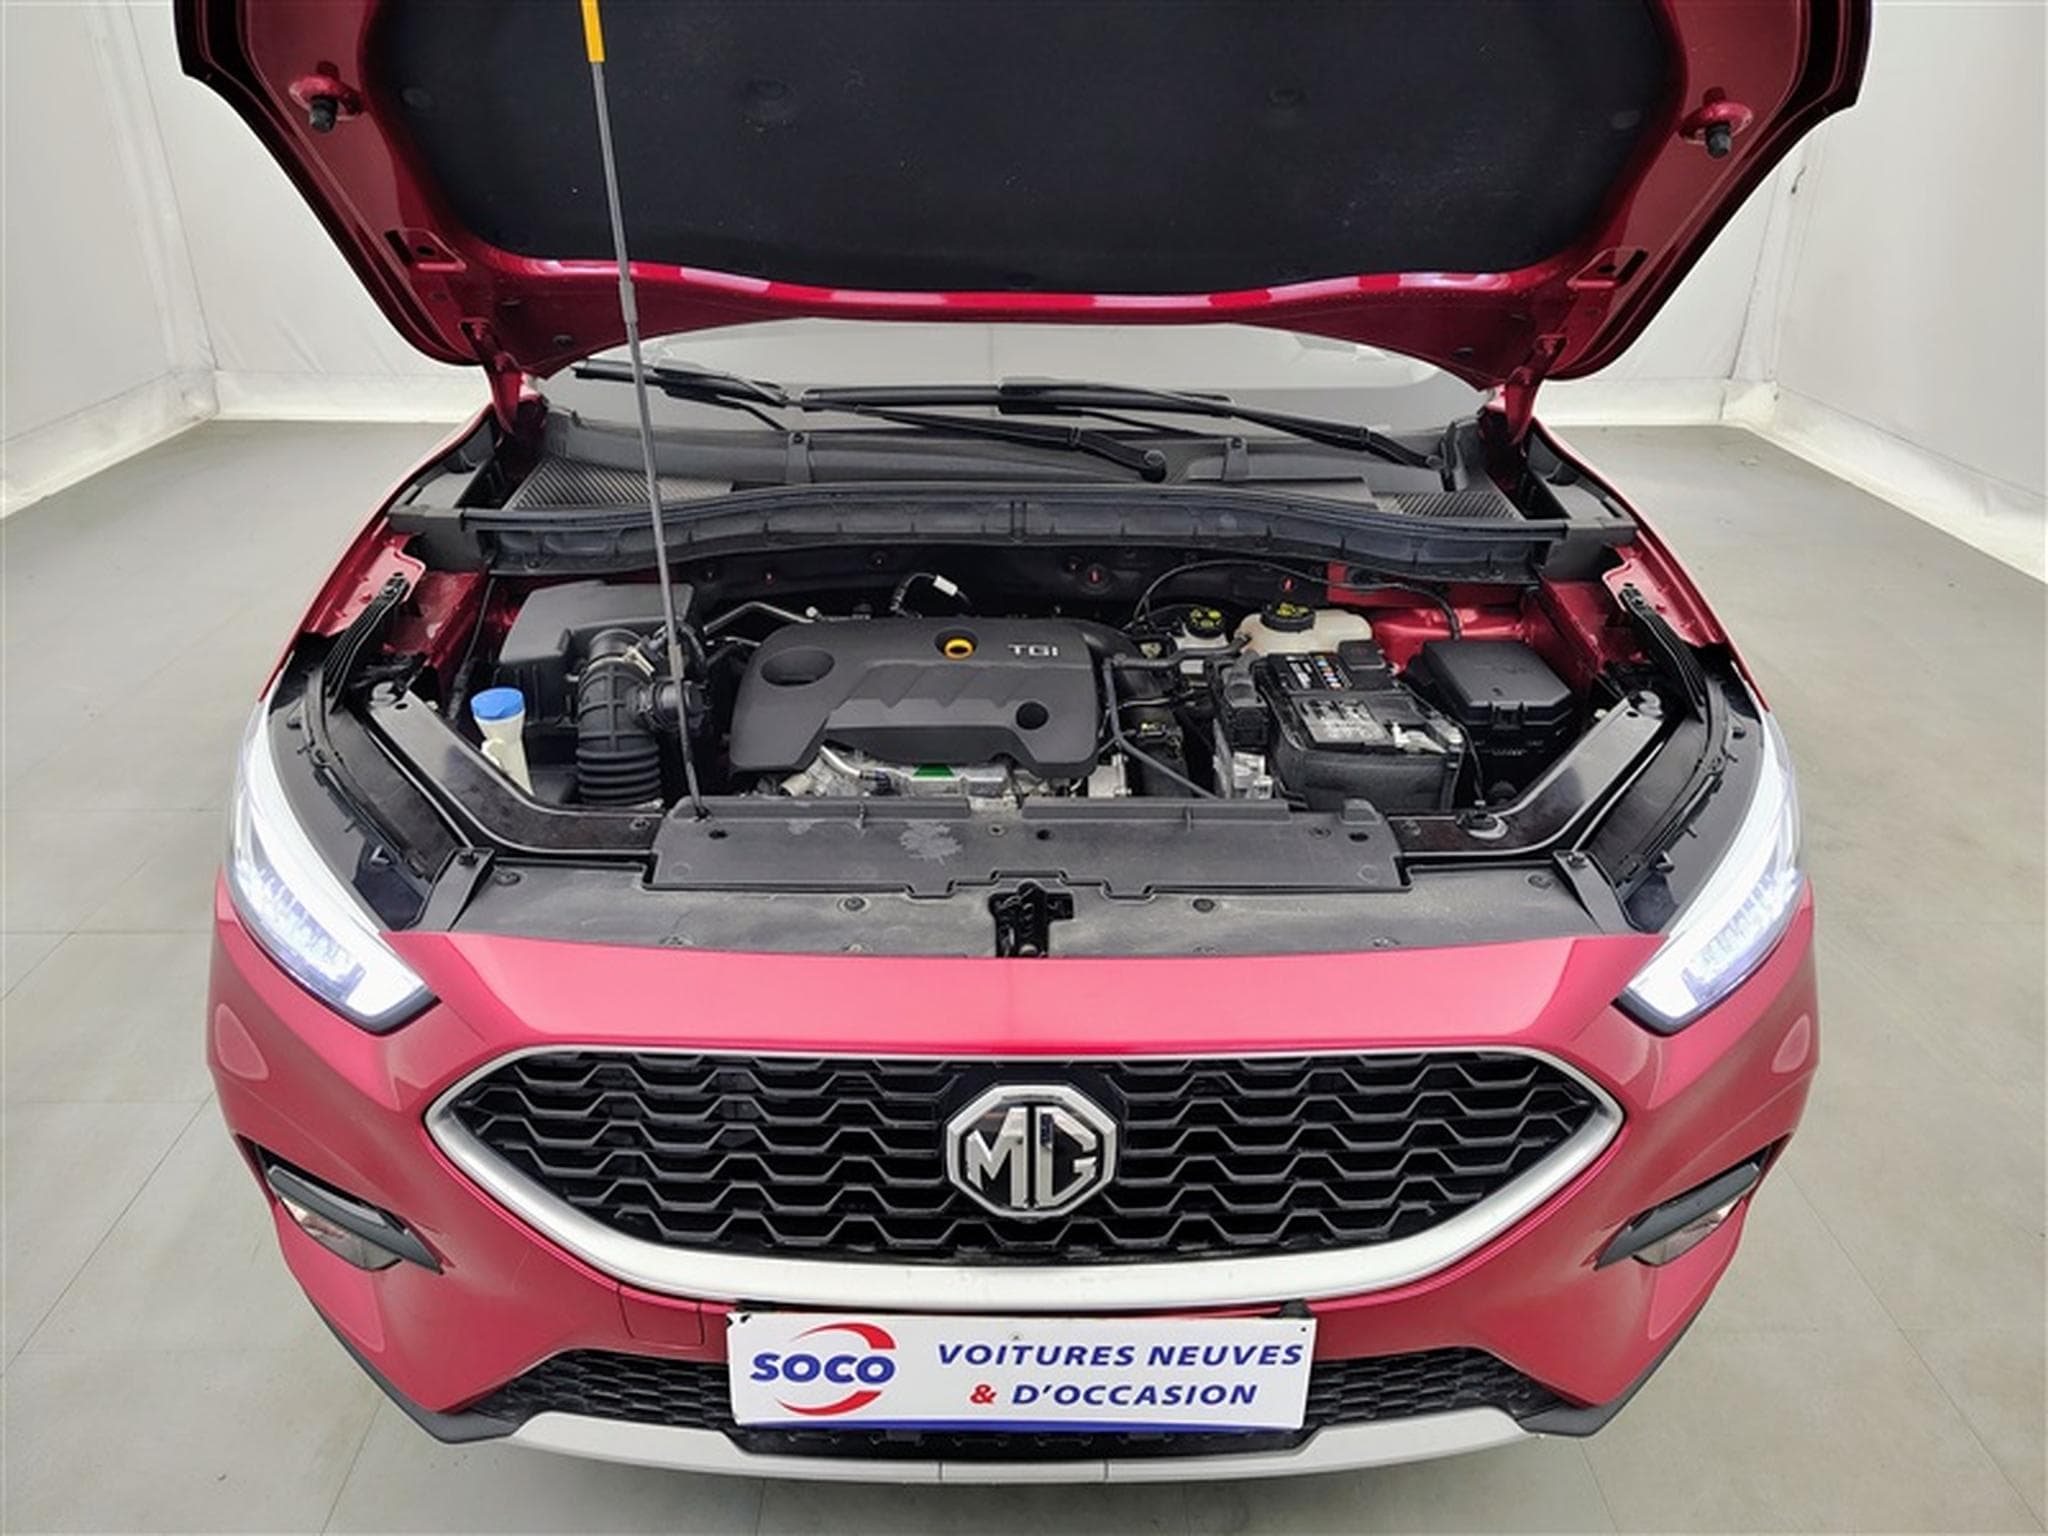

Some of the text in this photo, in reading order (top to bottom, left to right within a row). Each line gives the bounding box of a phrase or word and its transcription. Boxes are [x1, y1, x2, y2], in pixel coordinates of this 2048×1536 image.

[1008, 644, 1059, 657] TGI
[965, 1106, 1098, 1209] MG
[938, 1343, 1304, 1366] VOITURES NEUVES
[750, 1351, 897, 1385] SOCO
[969, 1383, 1259, 1406] & D'OCCASION
